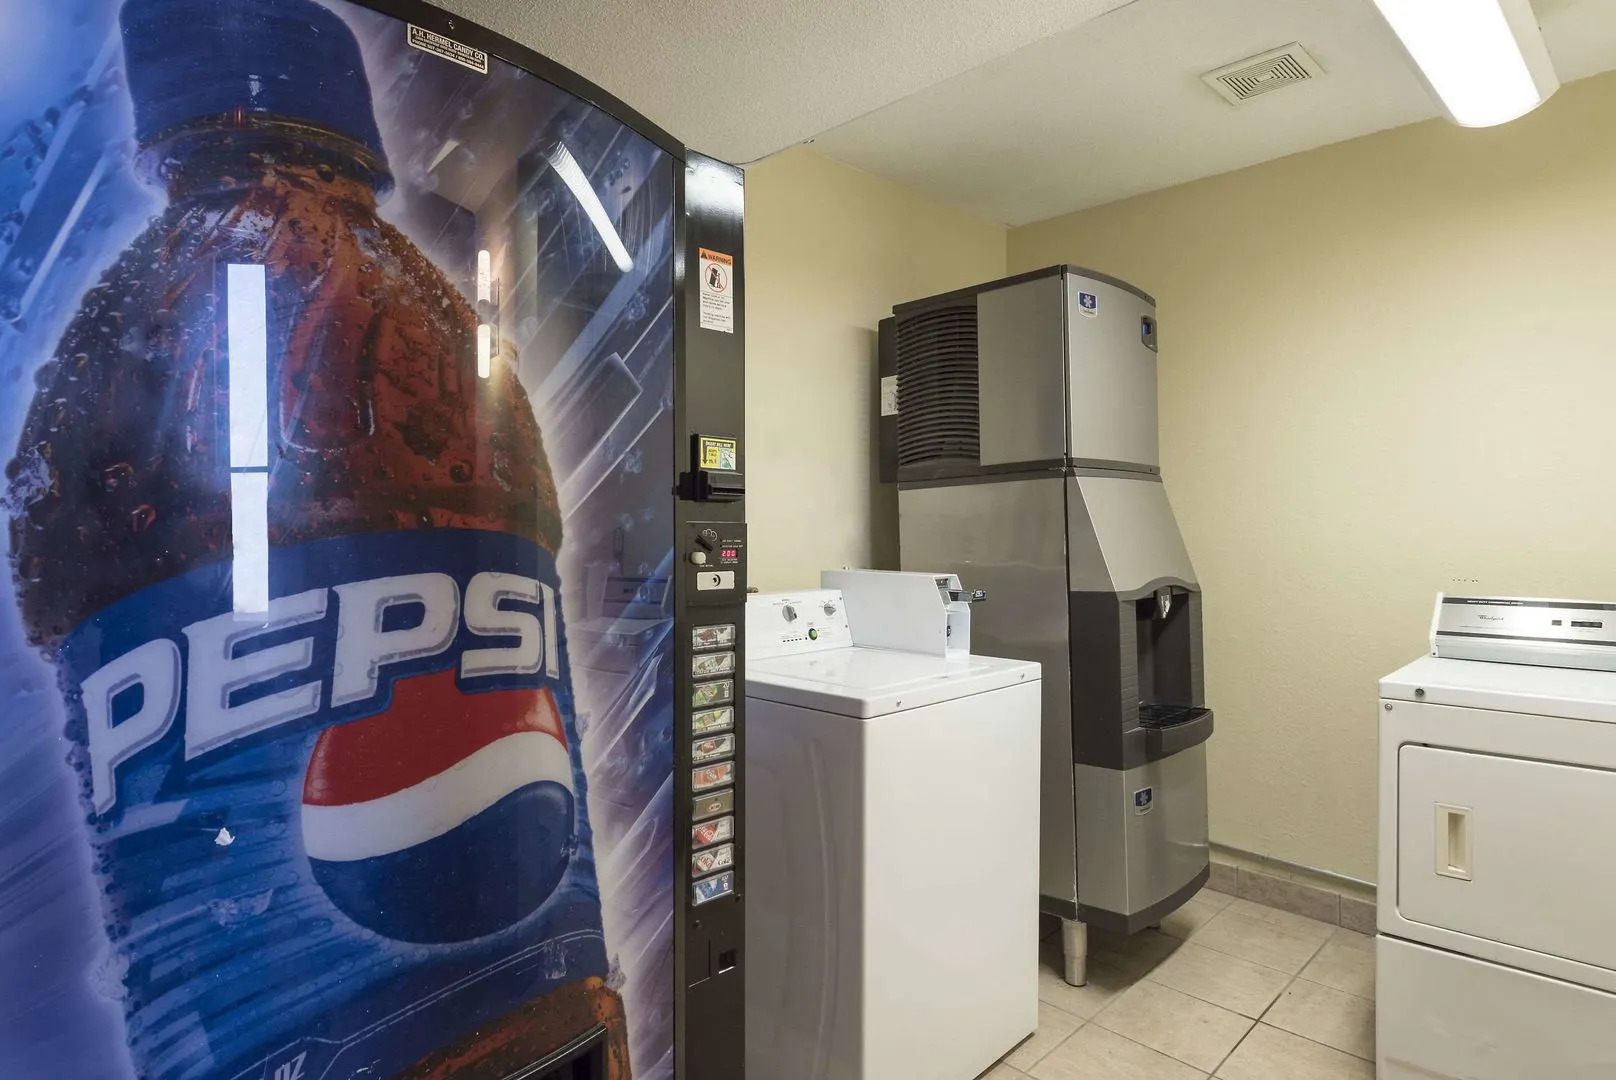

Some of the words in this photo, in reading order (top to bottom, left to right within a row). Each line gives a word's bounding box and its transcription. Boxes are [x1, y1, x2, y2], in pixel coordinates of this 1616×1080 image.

[427, 33, 453, 48] HERMEL
[453, 42, 474, 56] CANDY
[474, 50, 485, 61] CO.
[708, 254, 731, 265] WARNING
[81, 571, 561, 817] PEPSI
